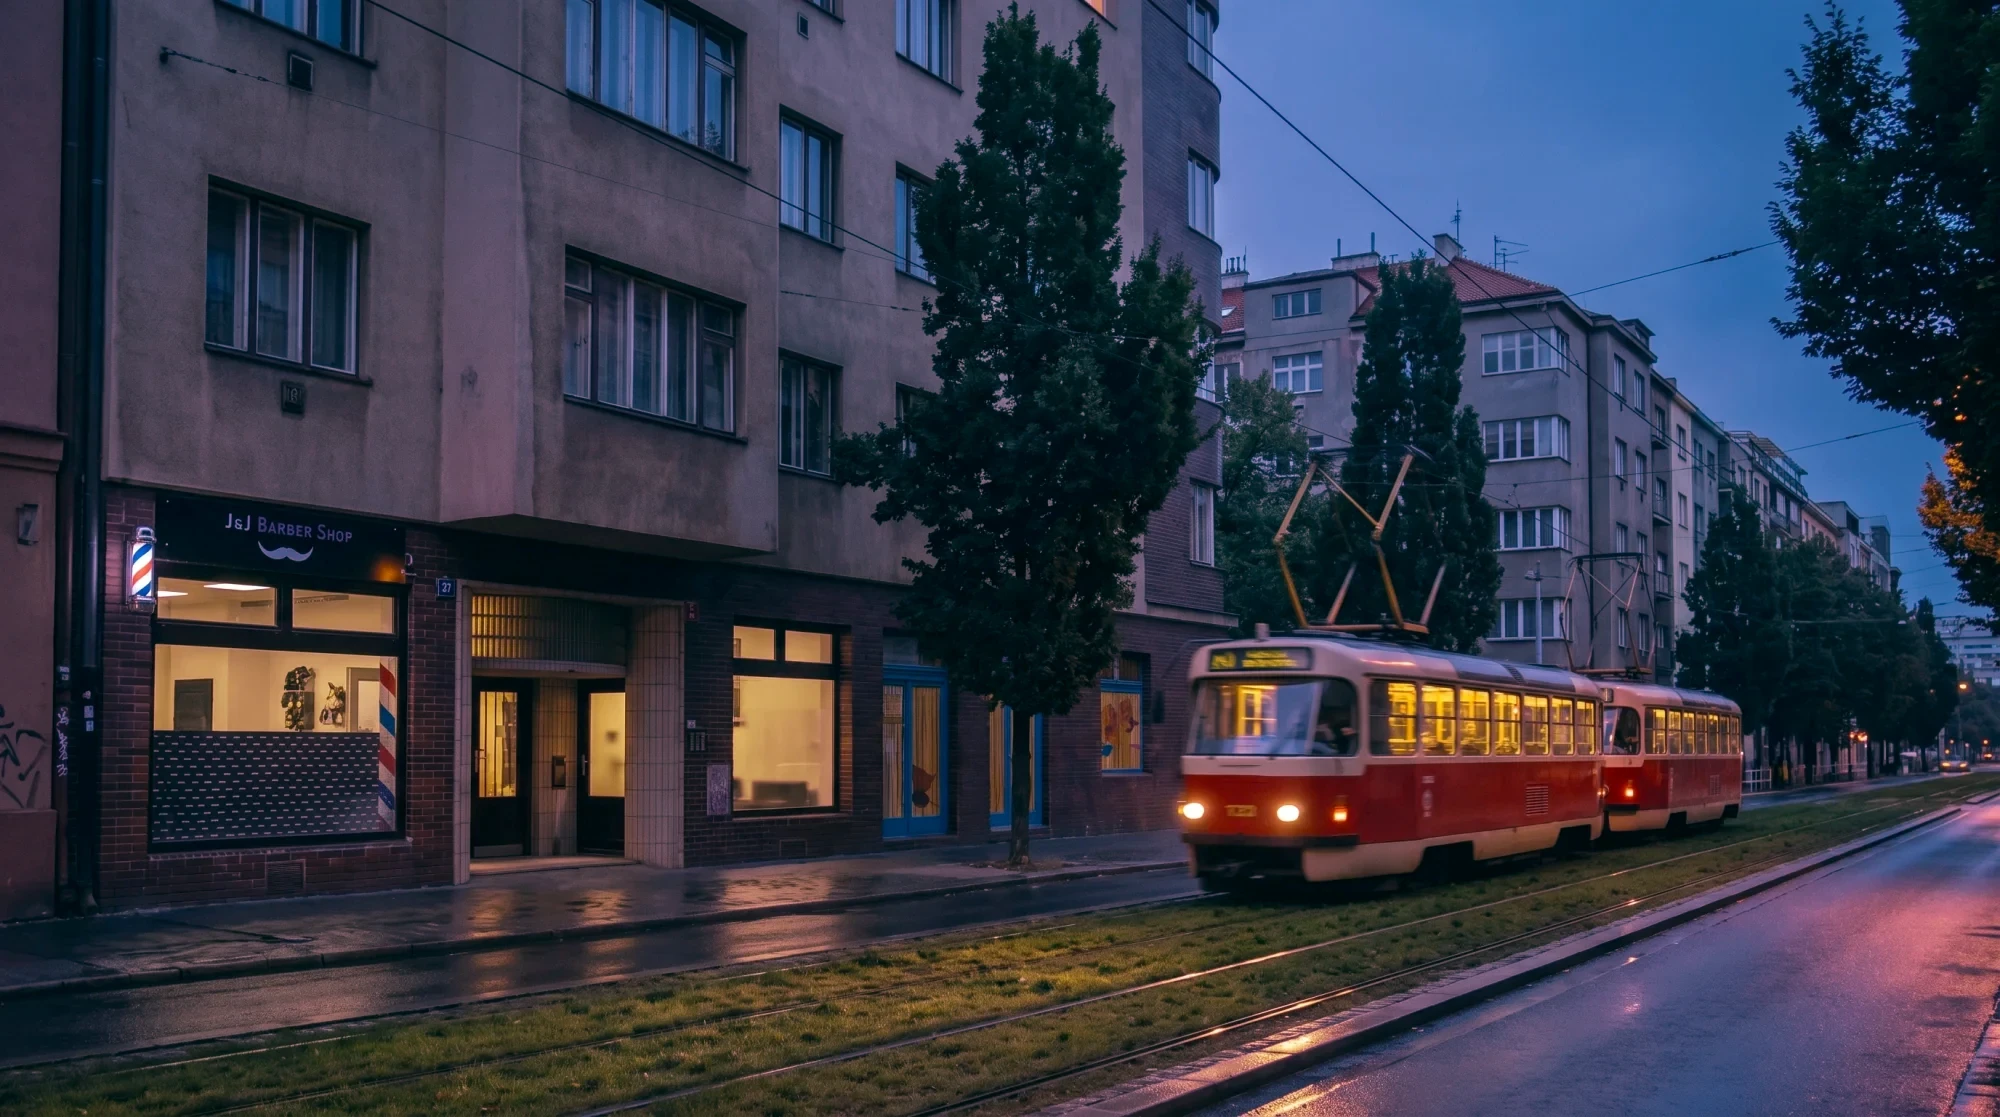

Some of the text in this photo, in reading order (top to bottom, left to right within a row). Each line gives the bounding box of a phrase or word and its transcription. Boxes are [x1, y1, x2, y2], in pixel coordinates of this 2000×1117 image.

[225, 513, 353, 542] J&J BARBER SHOP
[441, 582, 452, 593] 27
